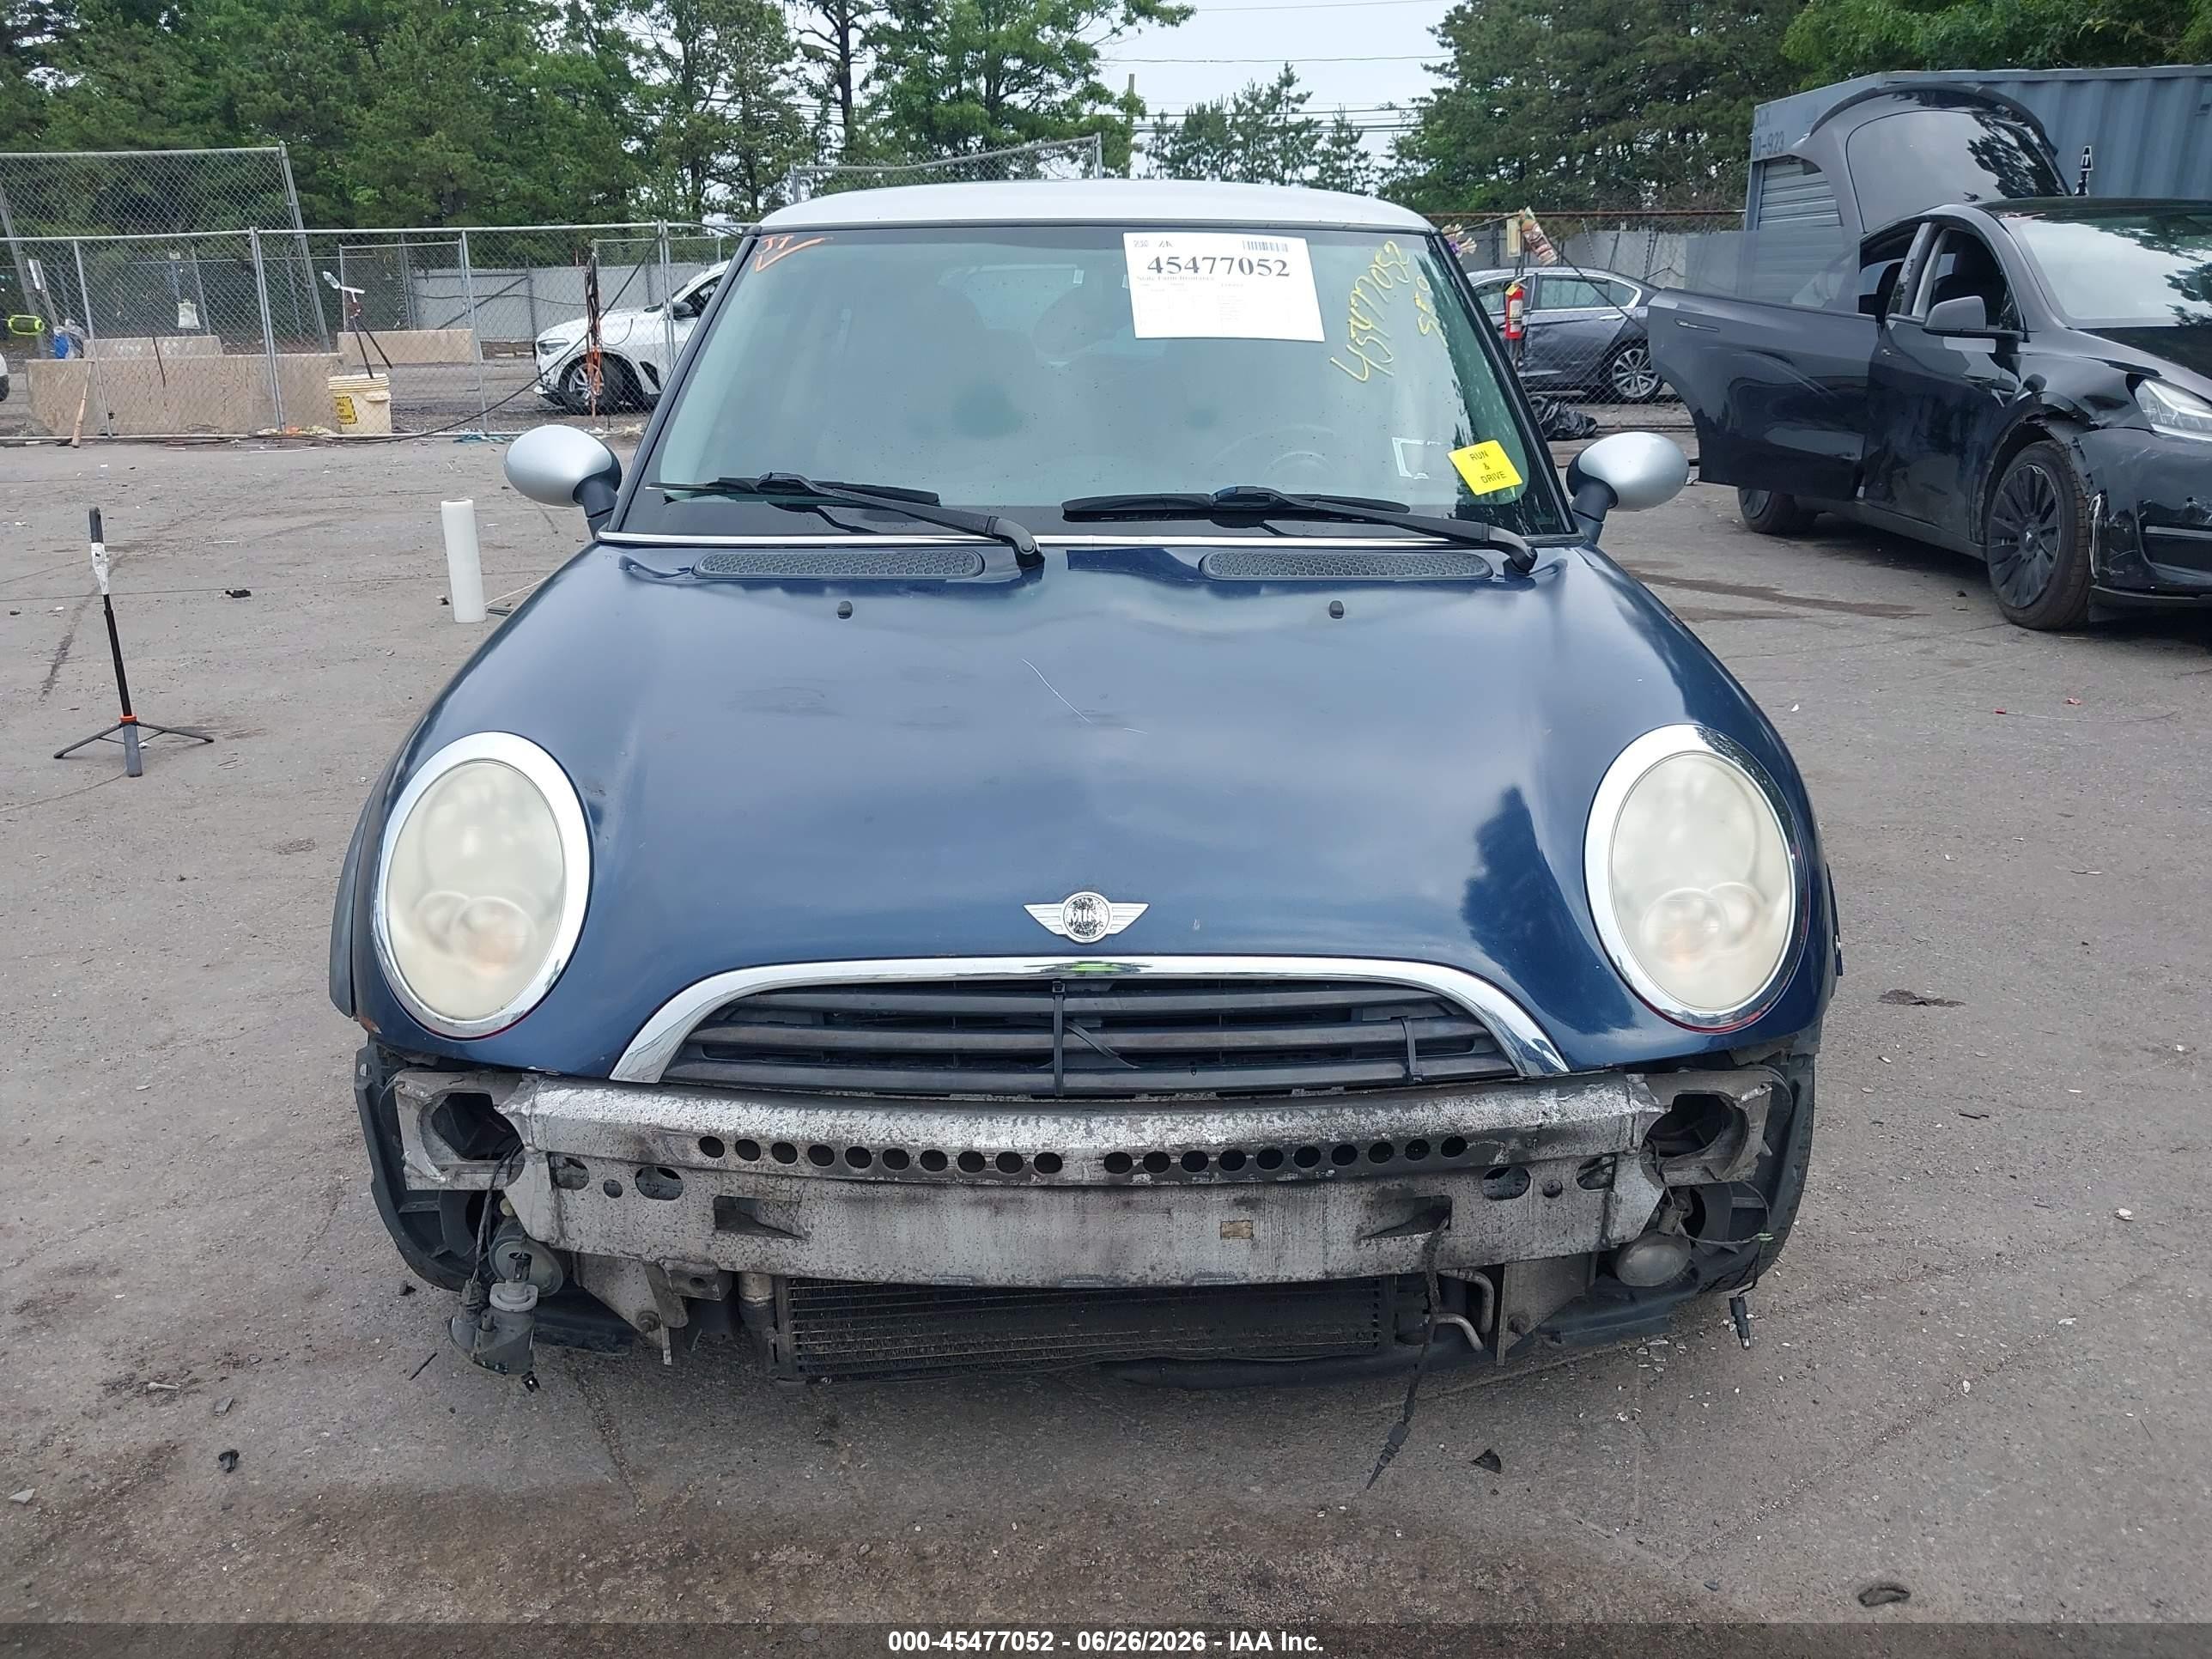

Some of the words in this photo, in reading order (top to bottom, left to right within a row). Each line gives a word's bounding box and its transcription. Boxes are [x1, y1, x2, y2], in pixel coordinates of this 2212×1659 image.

[1146, 256, 1291, 276] 45477052
[1469, 450, 1489, 461] RUN
[1483, 462, 1491, 471] &
[1480, 471, 1508, 483] DRIVE
